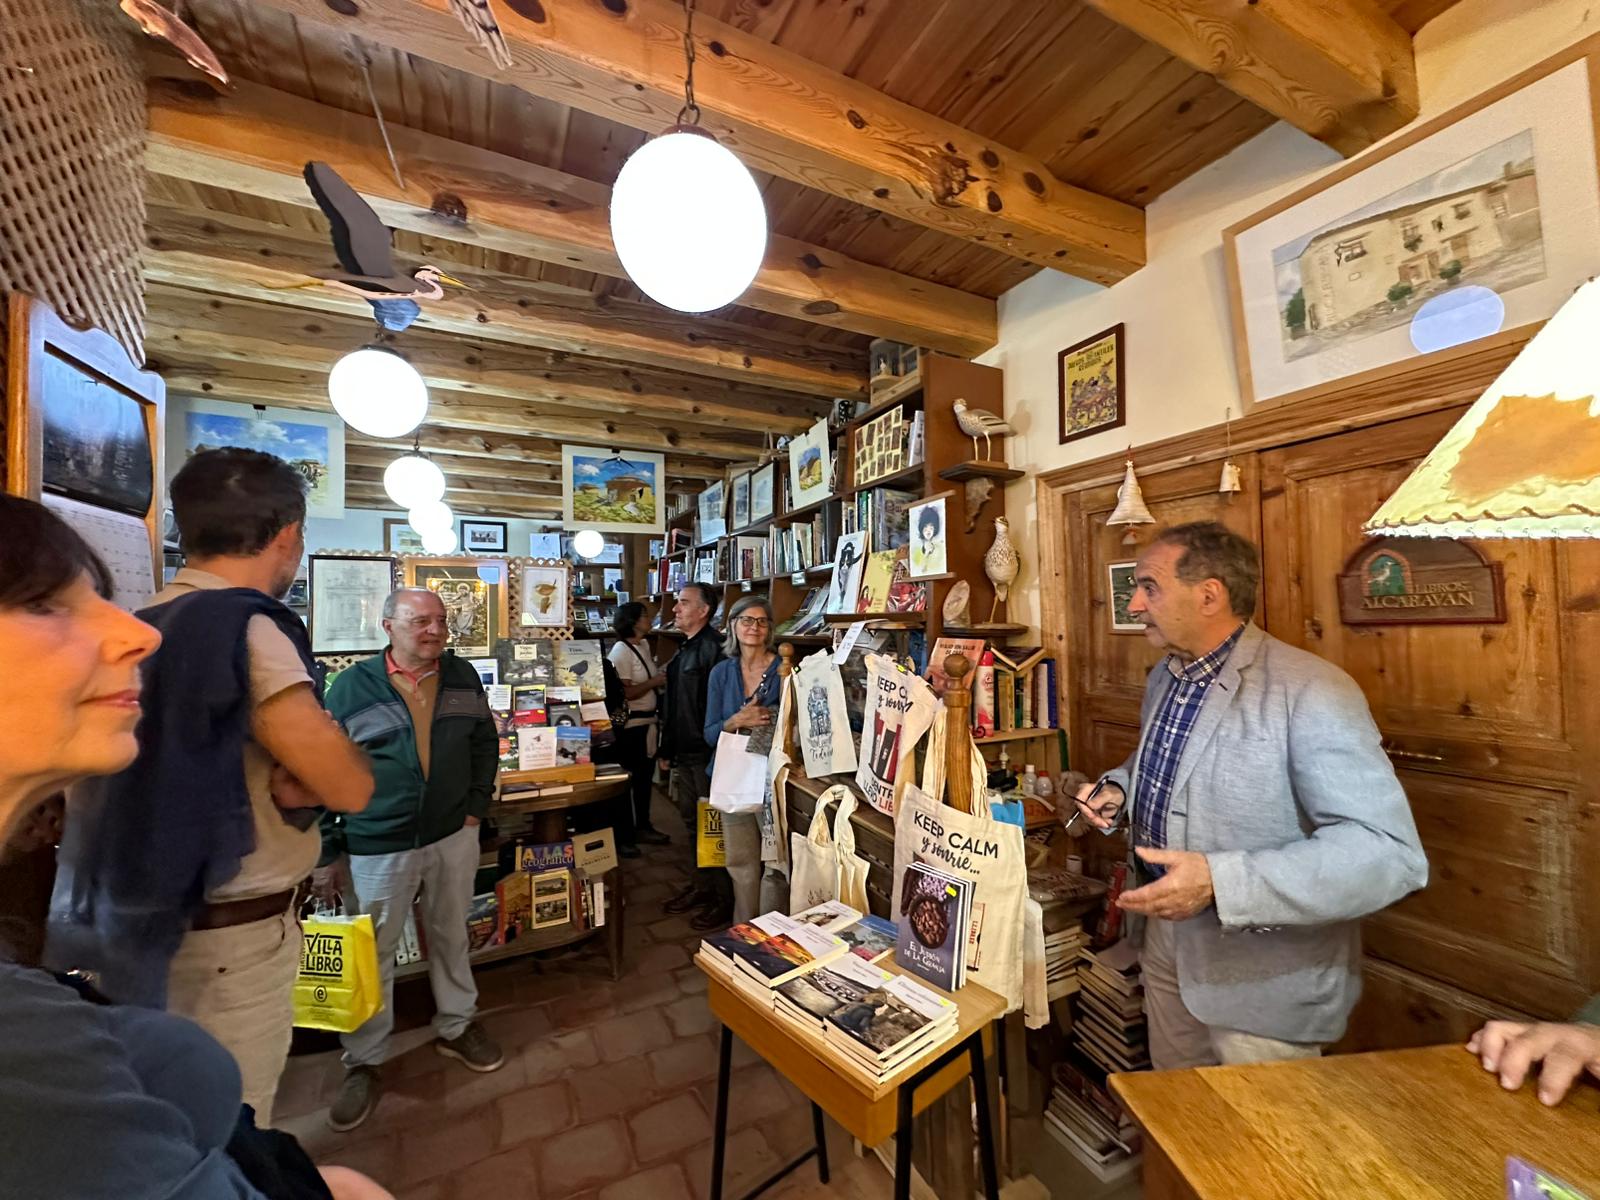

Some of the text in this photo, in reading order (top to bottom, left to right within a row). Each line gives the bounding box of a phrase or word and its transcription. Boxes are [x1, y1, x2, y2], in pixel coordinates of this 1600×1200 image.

[1415, 581, 1471, 593] LIBROS
[914, 811, 998, 858] KEEP CALM
[921, 836, 931, 853] y
[306, 932, 343, 956] VILLA
[305, 954, 343, 972] LIBRO
